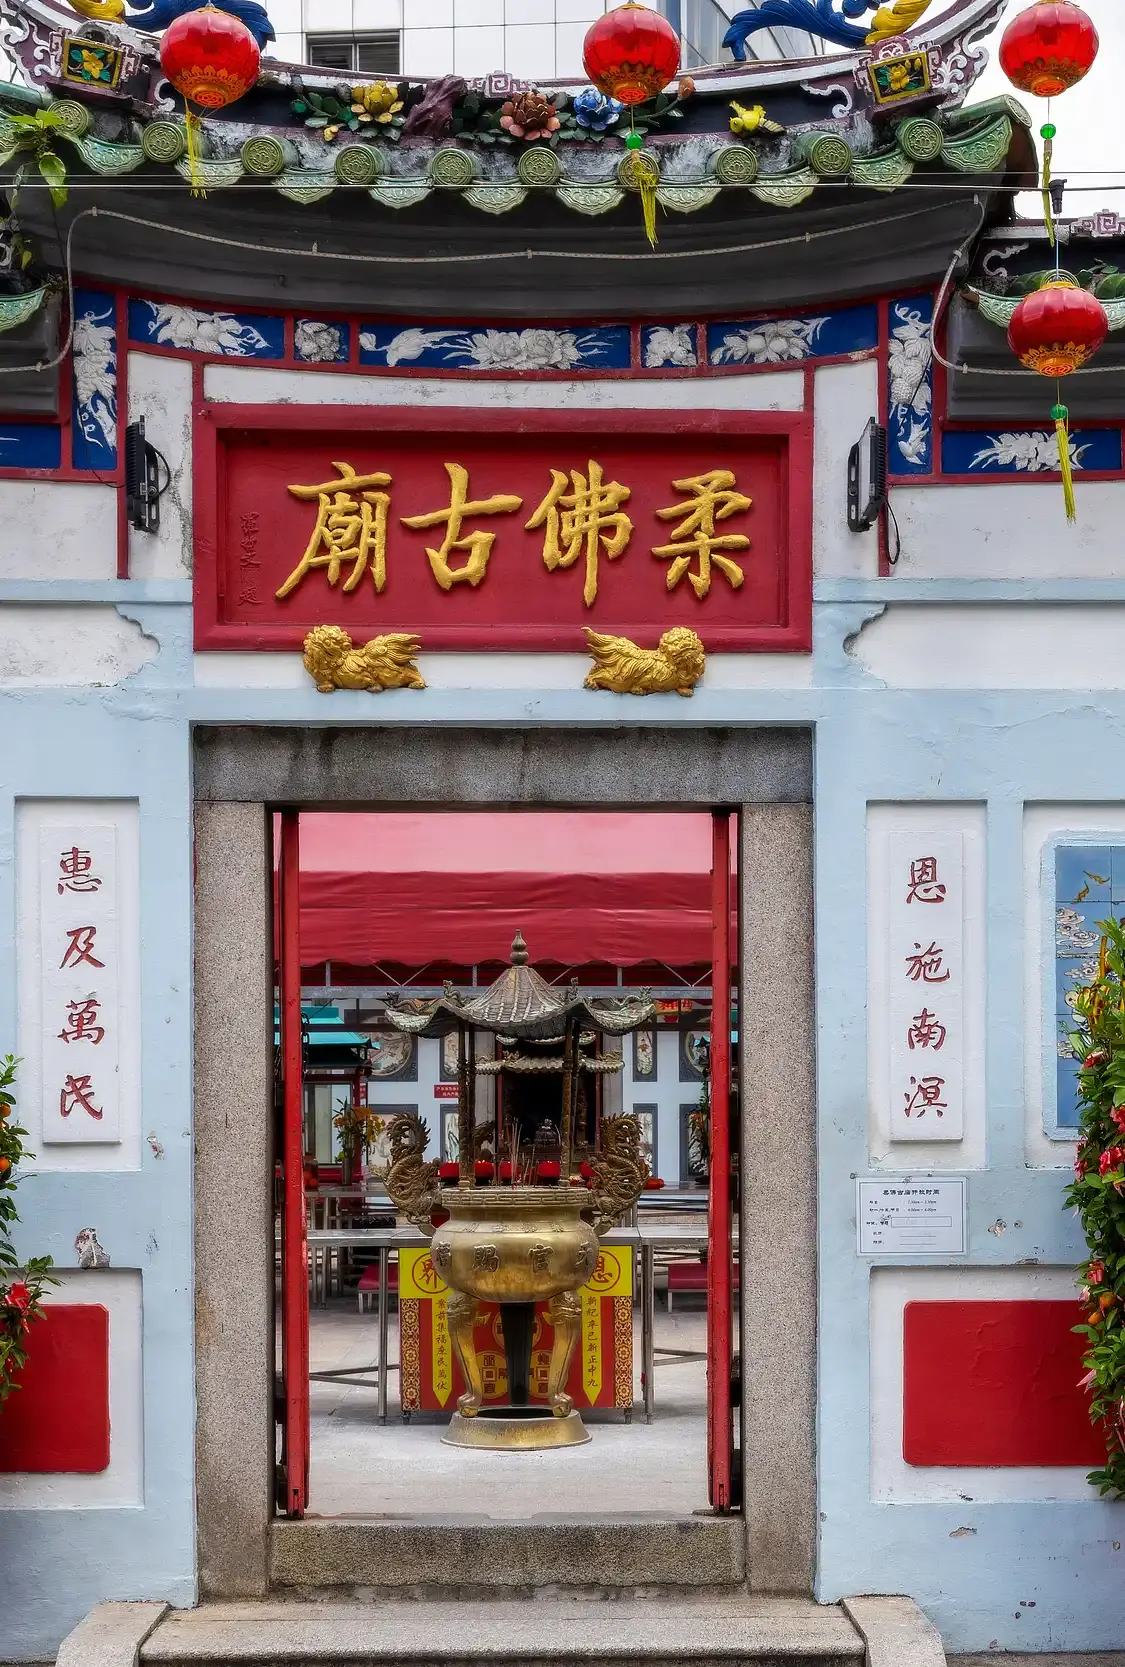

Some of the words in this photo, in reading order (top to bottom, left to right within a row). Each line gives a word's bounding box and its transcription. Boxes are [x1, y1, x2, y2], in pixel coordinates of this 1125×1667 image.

[274, 459, 754, 608] 柔佛古廟
[57, 846, 105, 1120] 惠及萬民
[904, 857, 951, 1119] 恩施南溟
